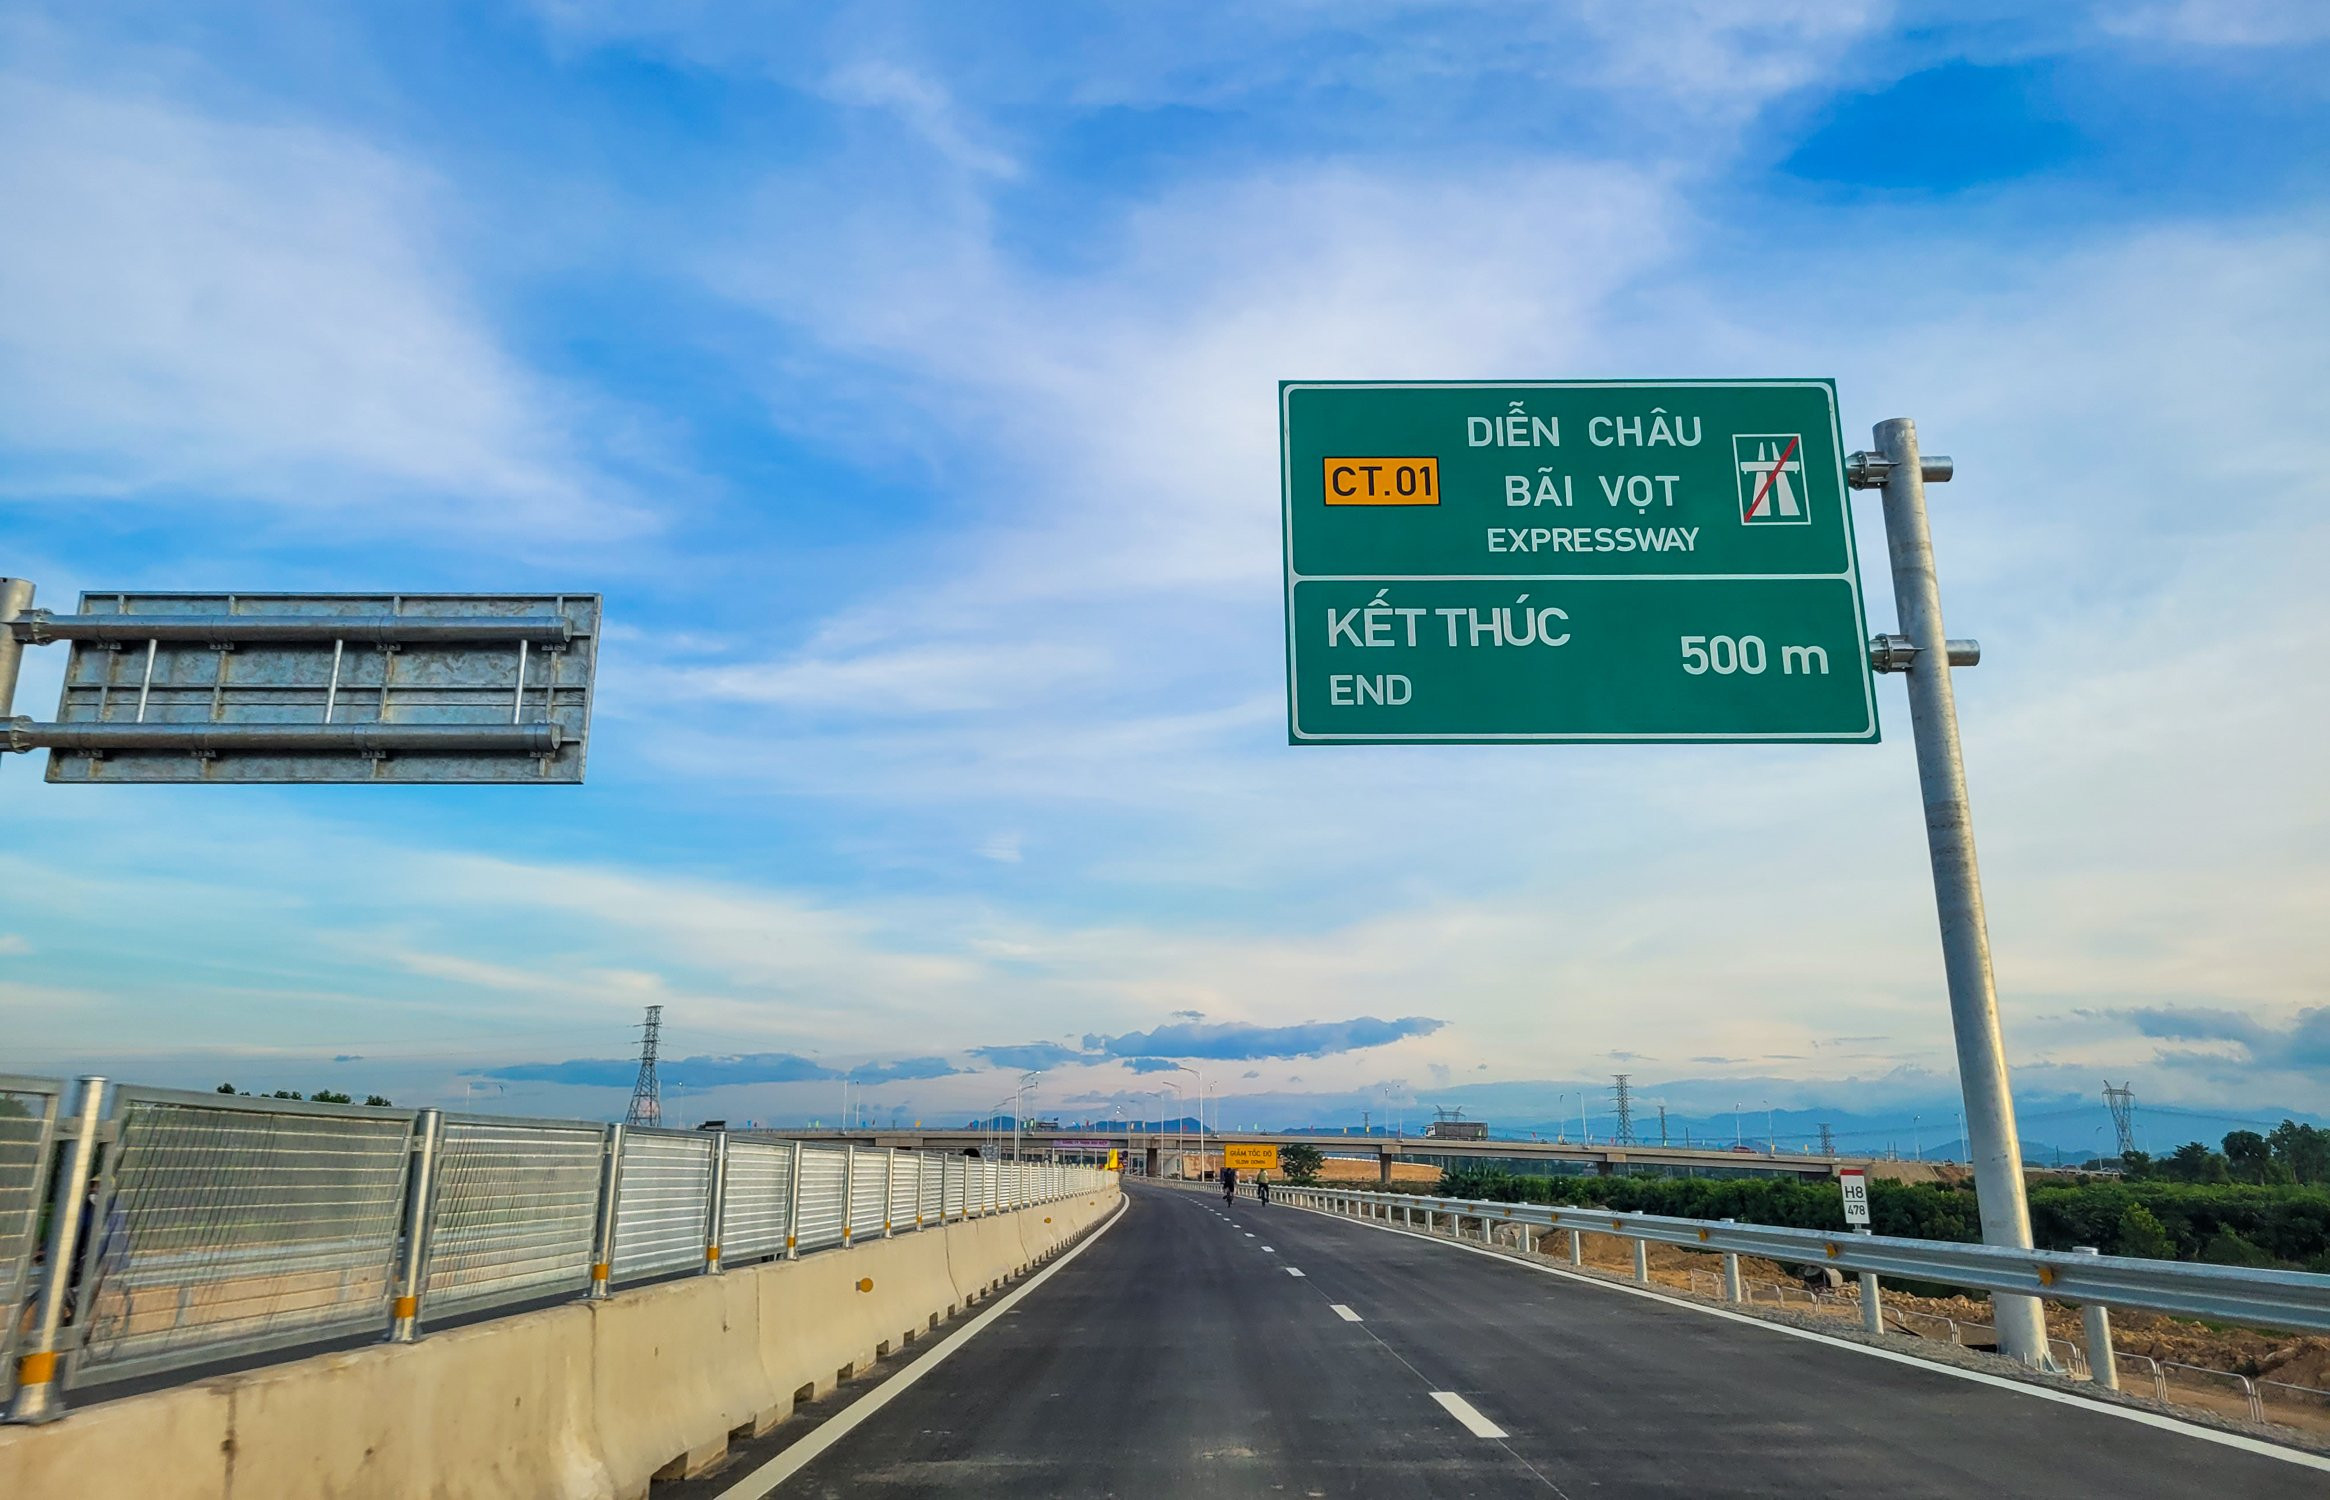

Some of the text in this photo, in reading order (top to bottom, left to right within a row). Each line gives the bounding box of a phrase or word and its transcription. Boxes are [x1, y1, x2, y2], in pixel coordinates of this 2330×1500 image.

[1467, 401, 1702, 447] DIỄN CHÂU
[1332, 465, 1432, 497] CT.01
[1505, 466, 1680, 515] BÃI VỌT
[1487, 527, 1700, 552] EXPRESSWAY
[1327, 588, 1571, 647] KẾT THÚC
[1680, 635, 1829, 675] 500 m
[1330, 674, 1412, 706] END
[1844, 1185, 1864, 1199] H8
[1848, 1204, 1866, 1216] 478
